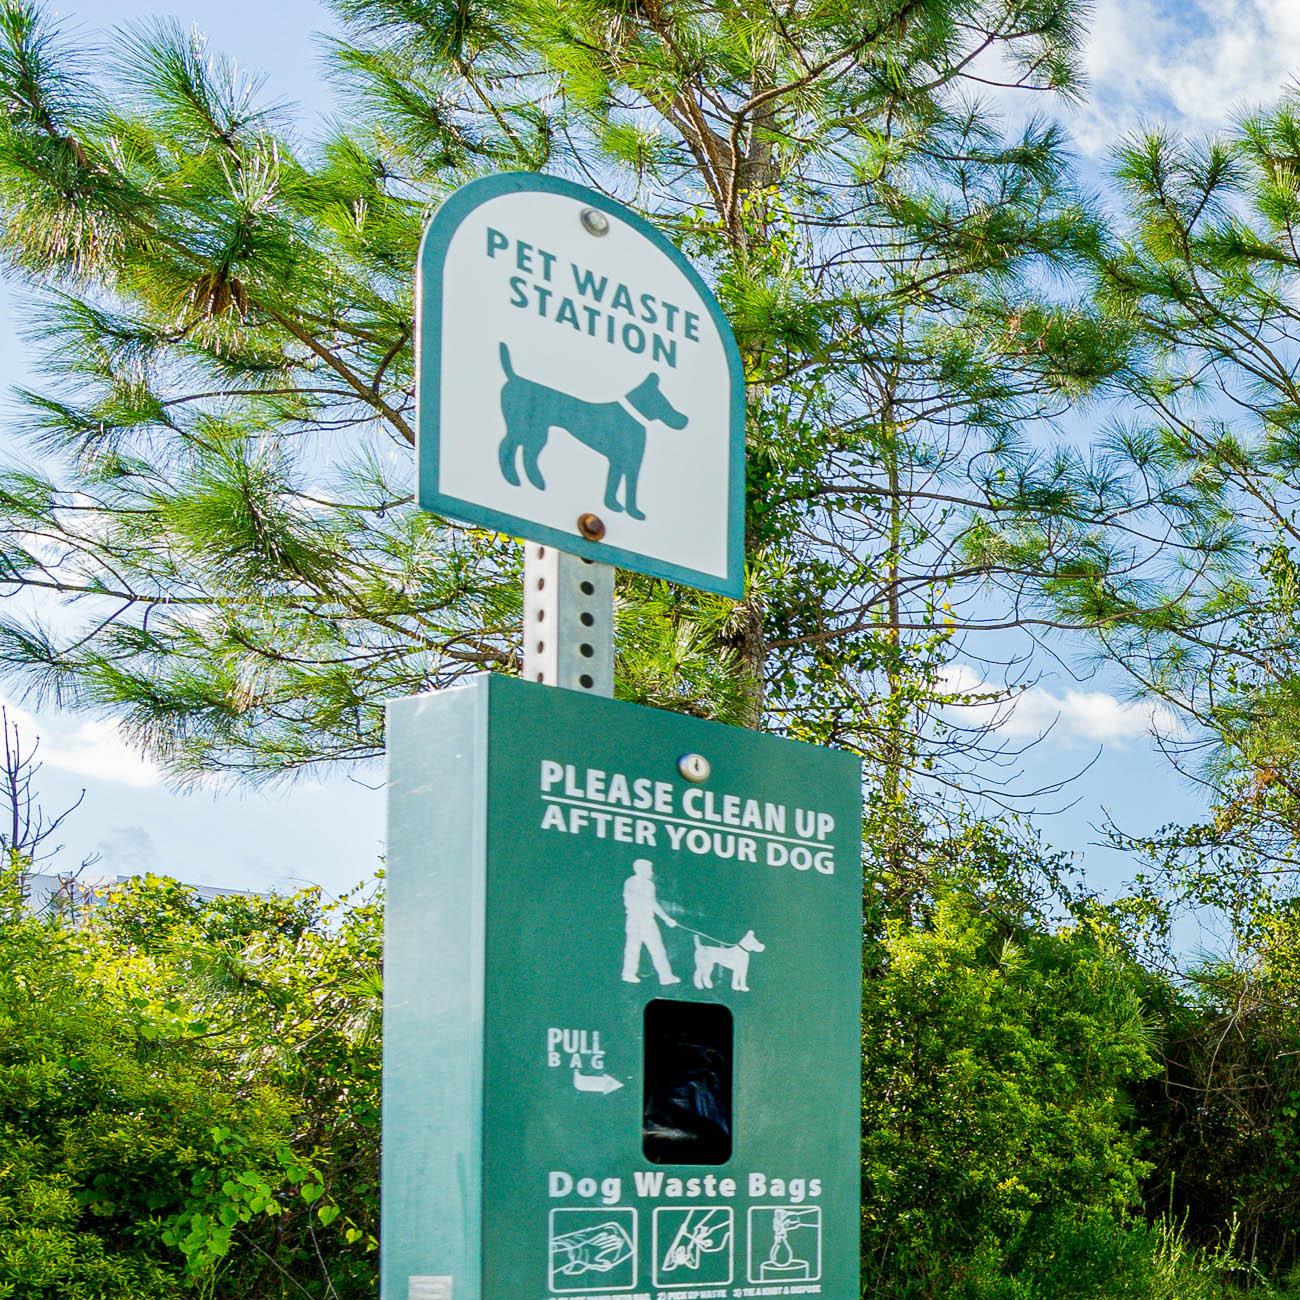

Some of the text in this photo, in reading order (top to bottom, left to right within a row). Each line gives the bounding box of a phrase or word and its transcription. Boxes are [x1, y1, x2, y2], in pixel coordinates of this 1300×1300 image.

[486, 226, 700, 343] PET WASTE
[509, 276, 678, 369] STATION
[540, 760, 835, 841] PLEASE CLEAN UP
[540, 804, 835, 875] AFTER YOUR DOG
[547, 1027, 606, 1055] PULL
[549, 1171, 822, 1204] Dog Waste Bags
